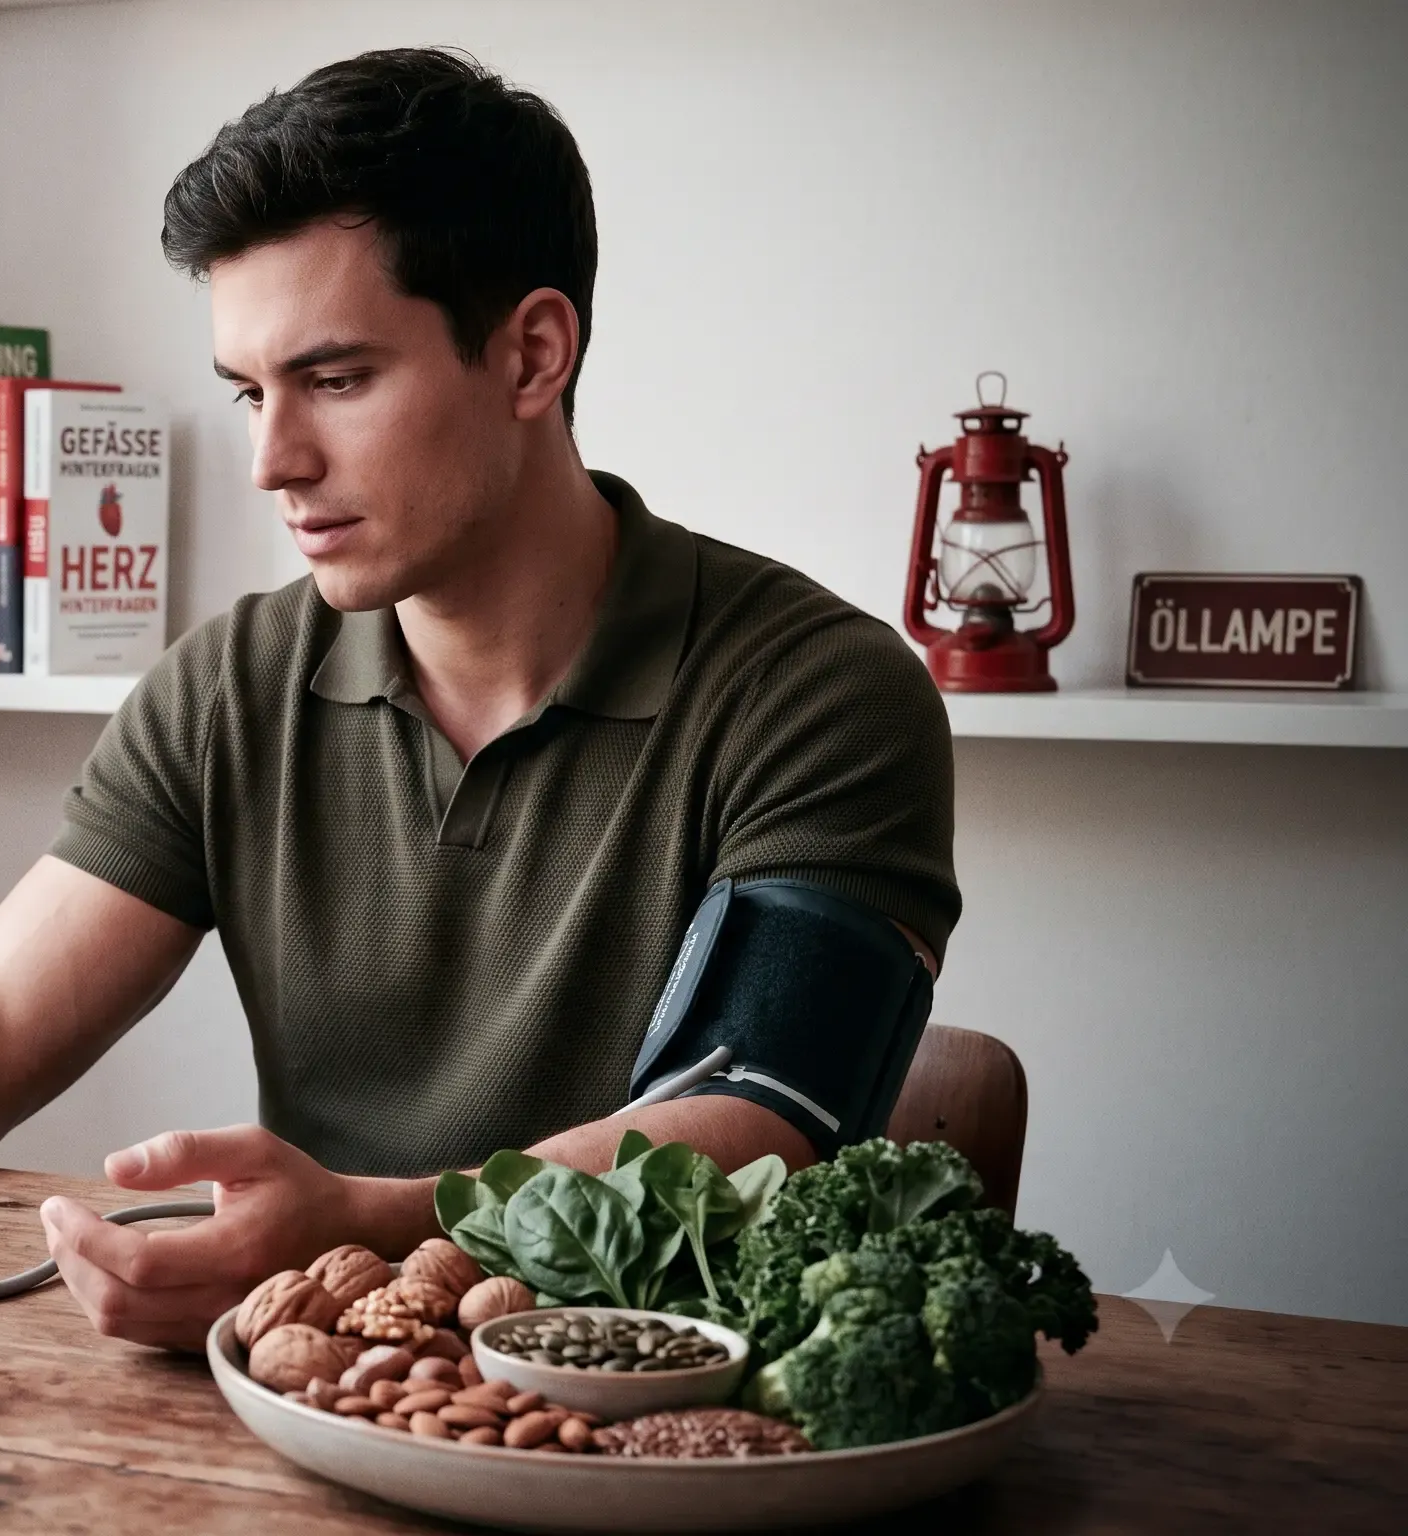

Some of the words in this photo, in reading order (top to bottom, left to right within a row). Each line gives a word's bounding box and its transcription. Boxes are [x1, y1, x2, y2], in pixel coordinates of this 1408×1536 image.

[60, 420, 162, 457] GEFÄSSE
[61, 545, 159, 592] HERZ
[1149, 598, 1338, 655] ÖLLAMPE
